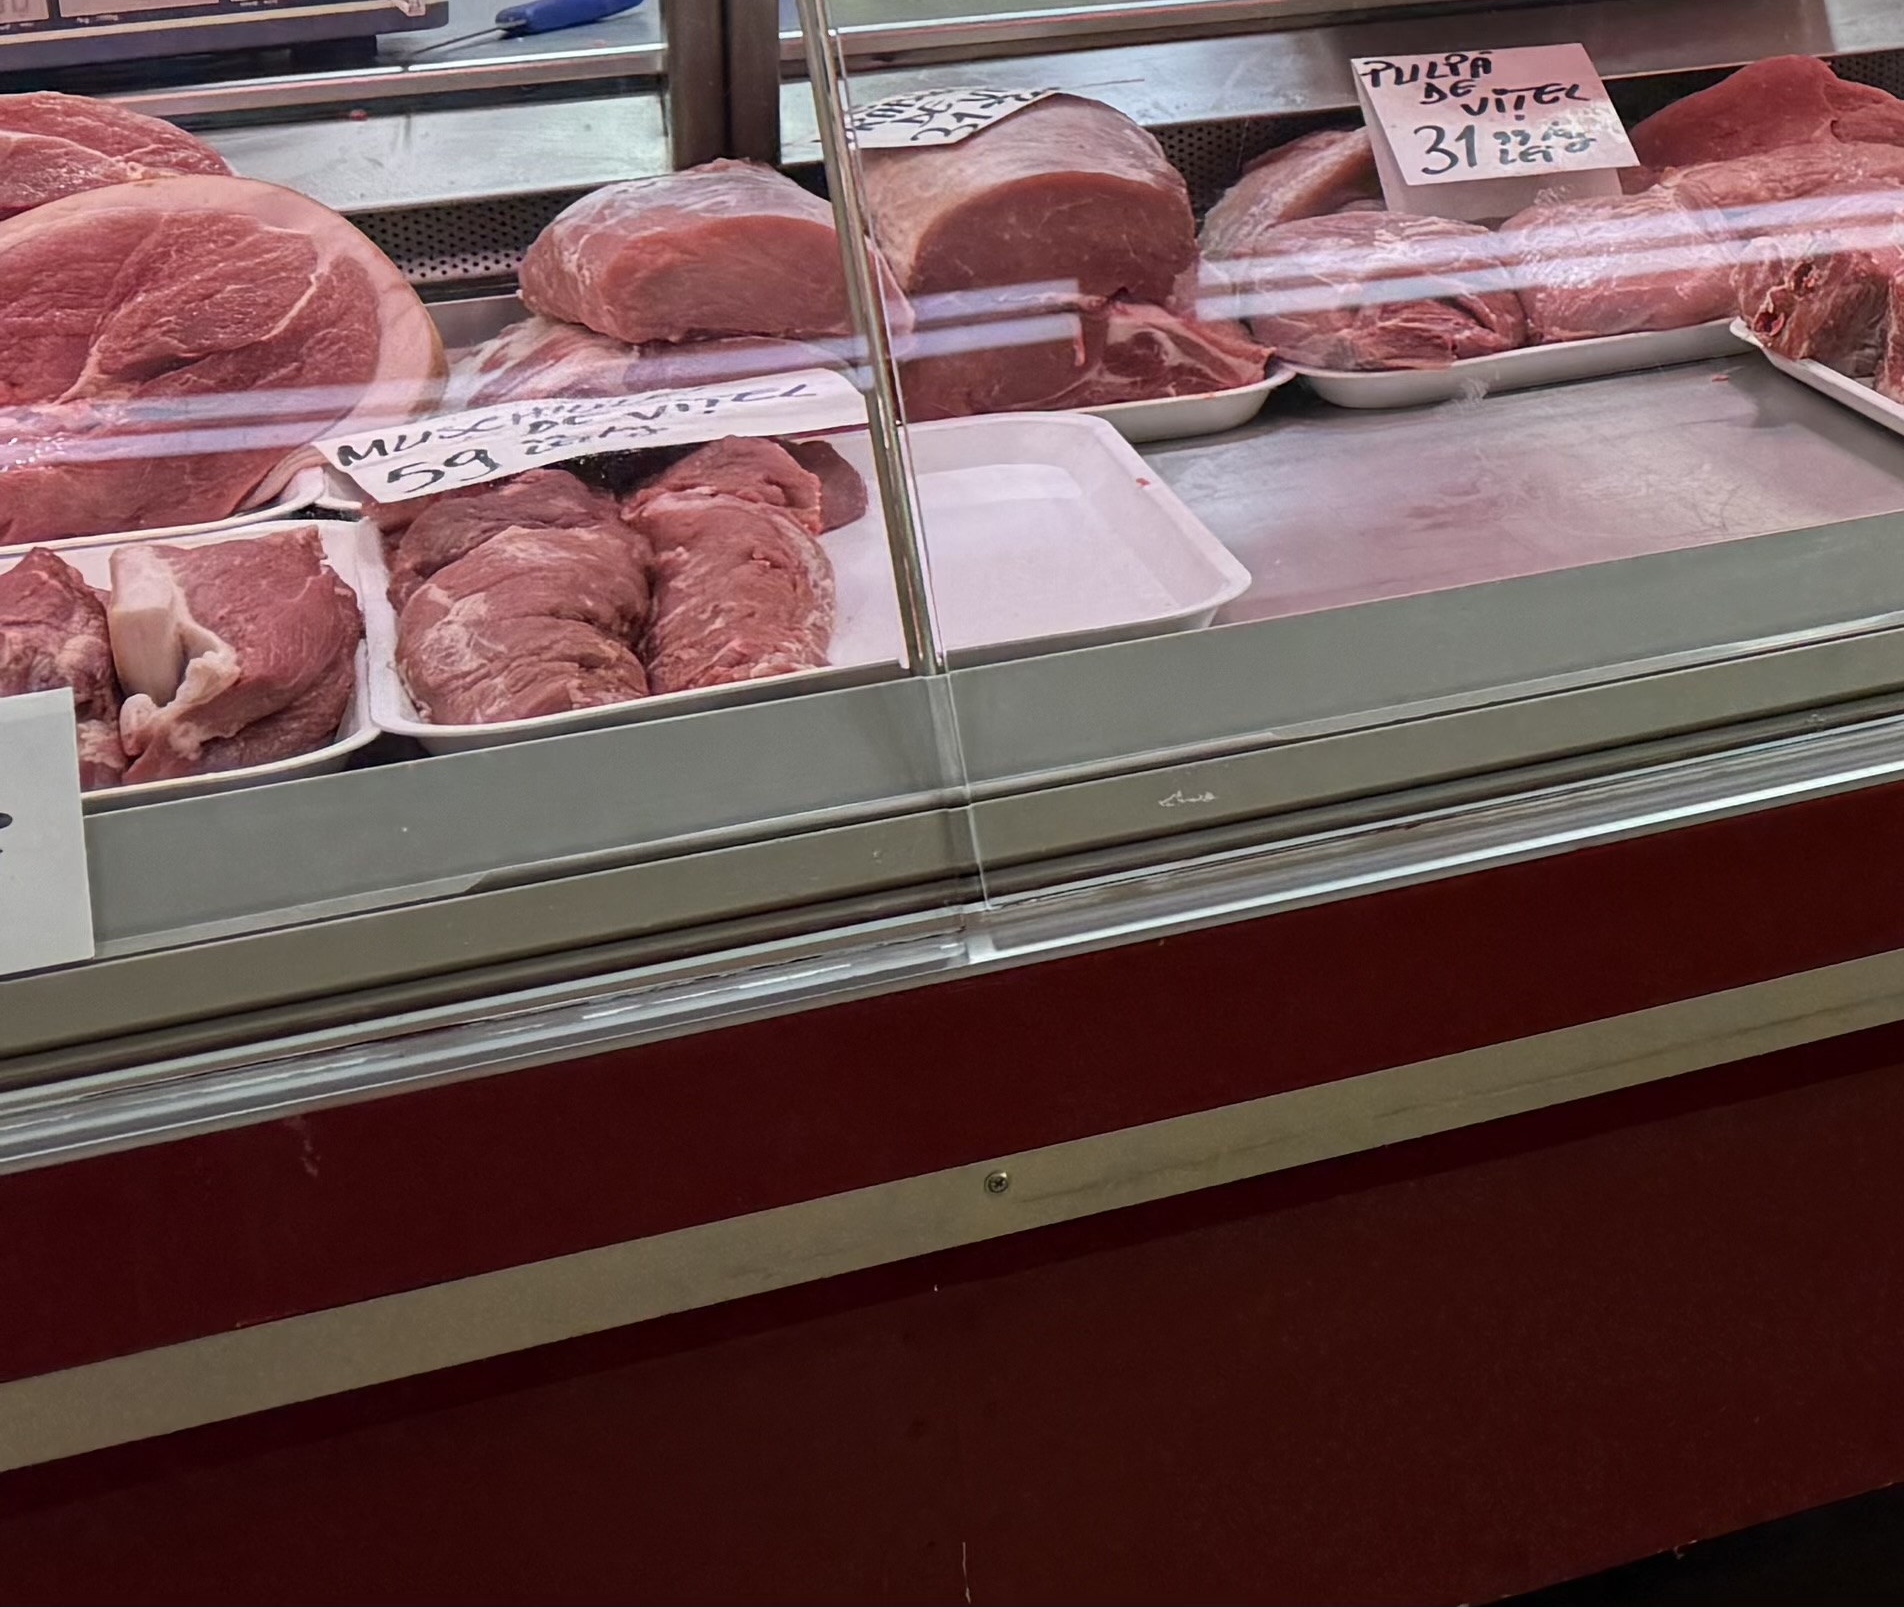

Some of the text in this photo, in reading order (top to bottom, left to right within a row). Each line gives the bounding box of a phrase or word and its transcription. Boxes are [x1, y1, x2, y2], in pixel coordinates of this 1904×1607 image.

[1419, 79, 1477, 104] DE
[1414, 124, 1478, 175] 31
[387, 448, 501, 494] 59
